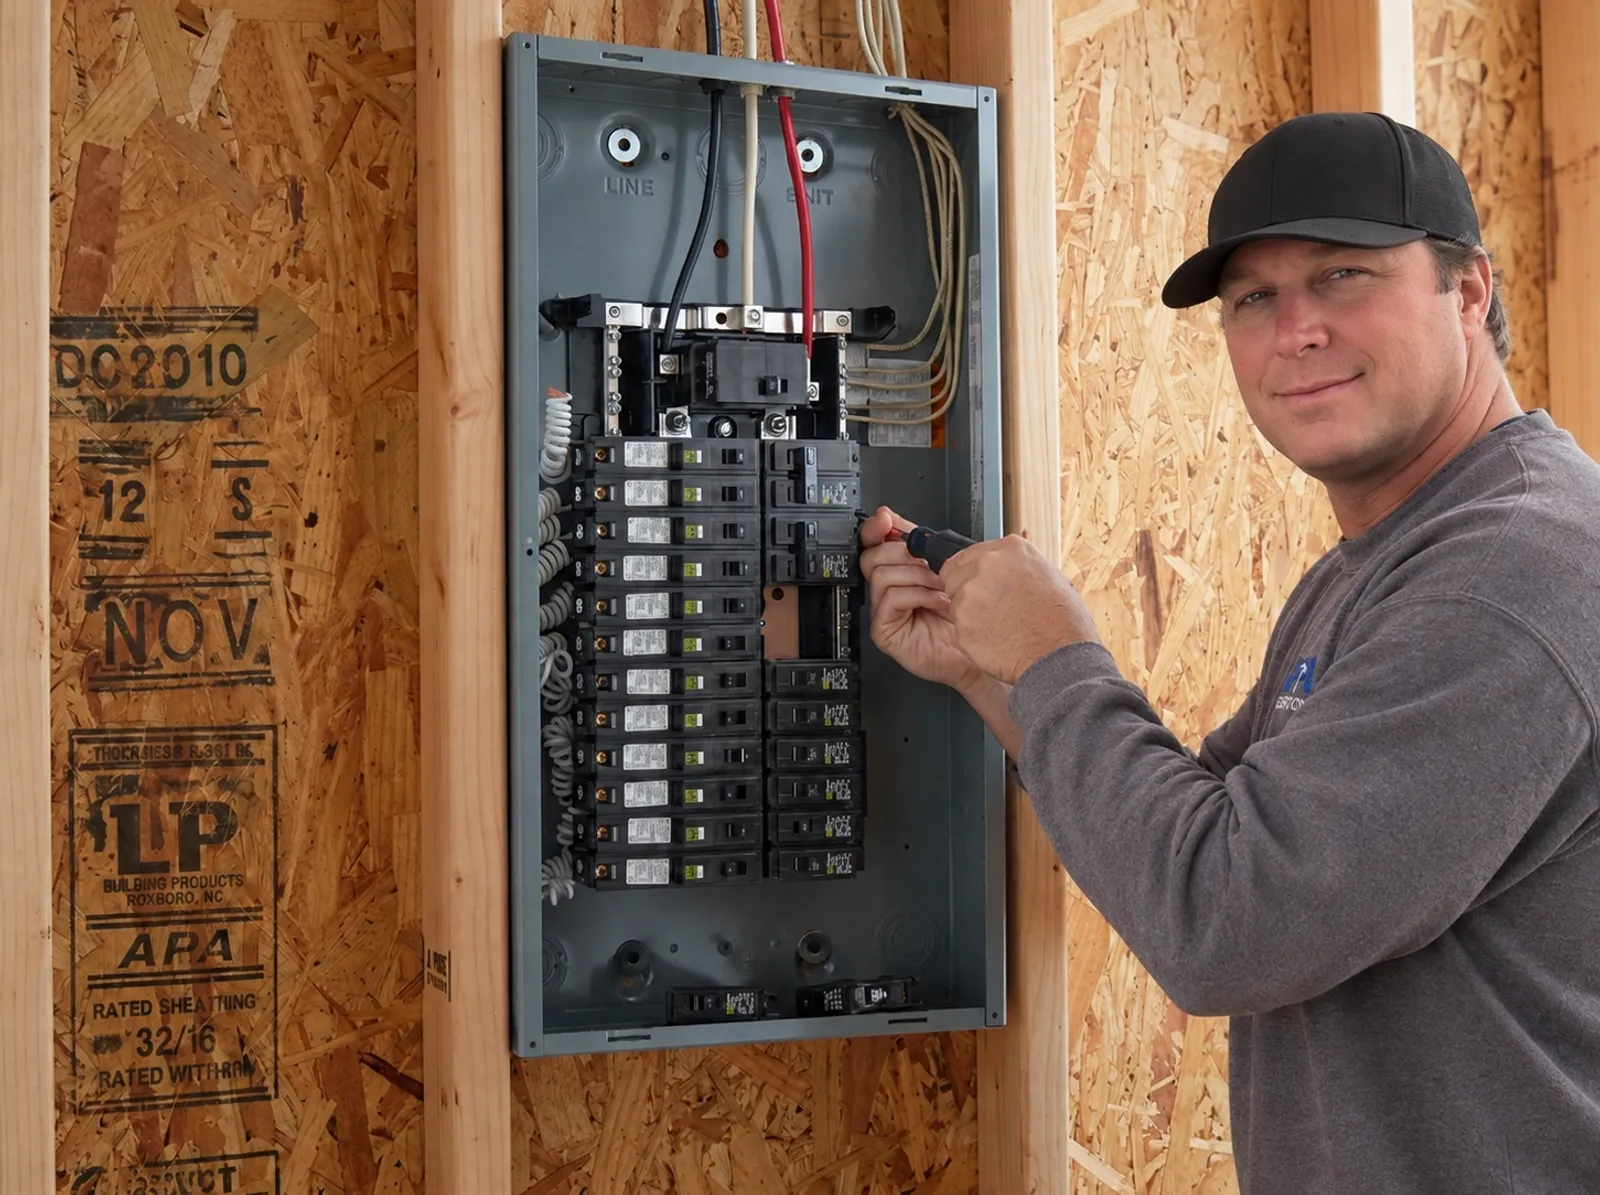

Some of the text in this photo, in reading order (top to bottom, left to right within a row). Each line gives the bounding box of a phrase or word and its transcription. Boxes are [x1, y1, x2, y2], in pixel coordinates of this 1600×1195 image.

[603, 177, 654, 197] LINE
[99, 479, 146, 522] 12
[231, 477, 253, 521] S
[102, 597, 259, 666] NOV
[109, 801, 238, 875] LP
[171, 873, 244, 890] PRODUCTS
[203, 890, 224, 904] NC
[118, 928, 233, 969] APA
[93, 1000, 153, 1020] RATED
[136, 1023, 217, 1058] 32/16
[99, 1066, 164, 1089] RATED
